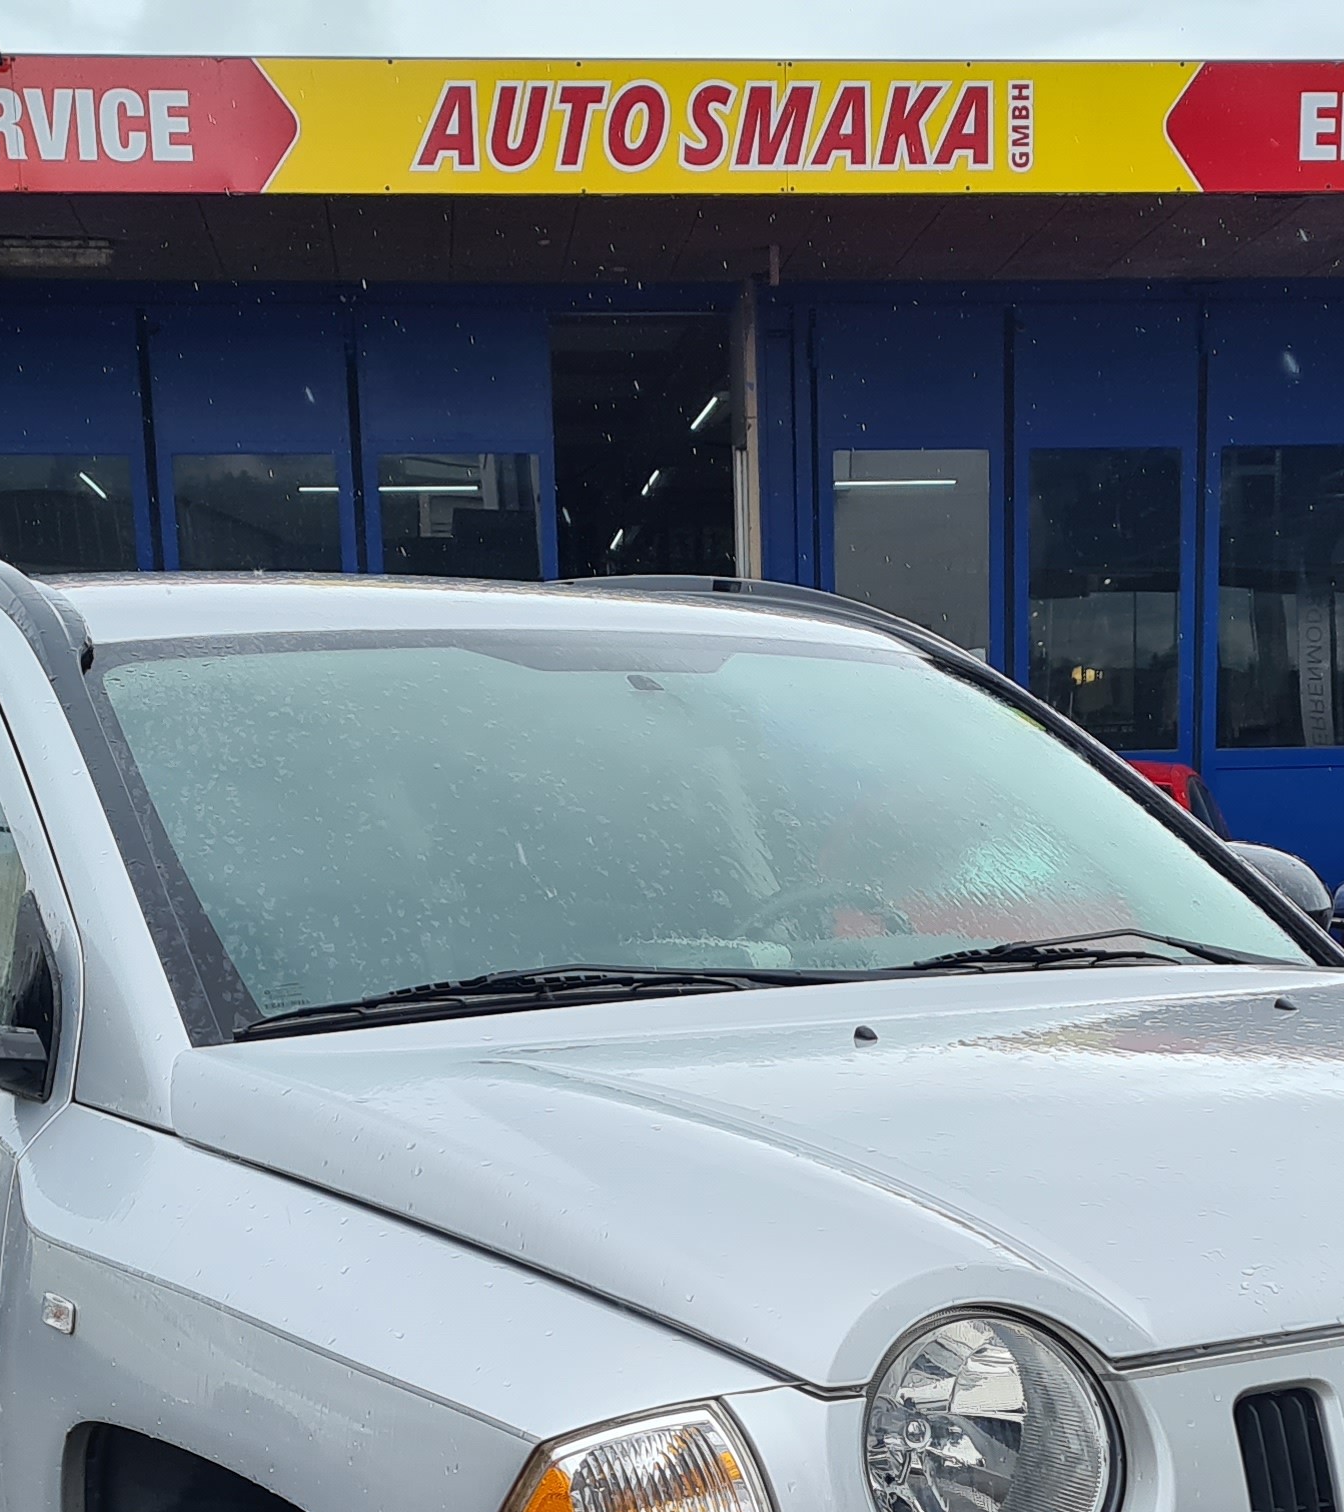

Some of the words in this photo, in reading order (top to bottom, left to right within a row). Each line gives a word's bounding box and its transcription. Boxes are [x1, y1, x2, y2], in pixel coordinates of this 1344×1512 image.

[410, 79, 670, 172] AUTO
[678, 79, 994, 172] SMAKA
[1010, 82, 1031, 170] GMBH
